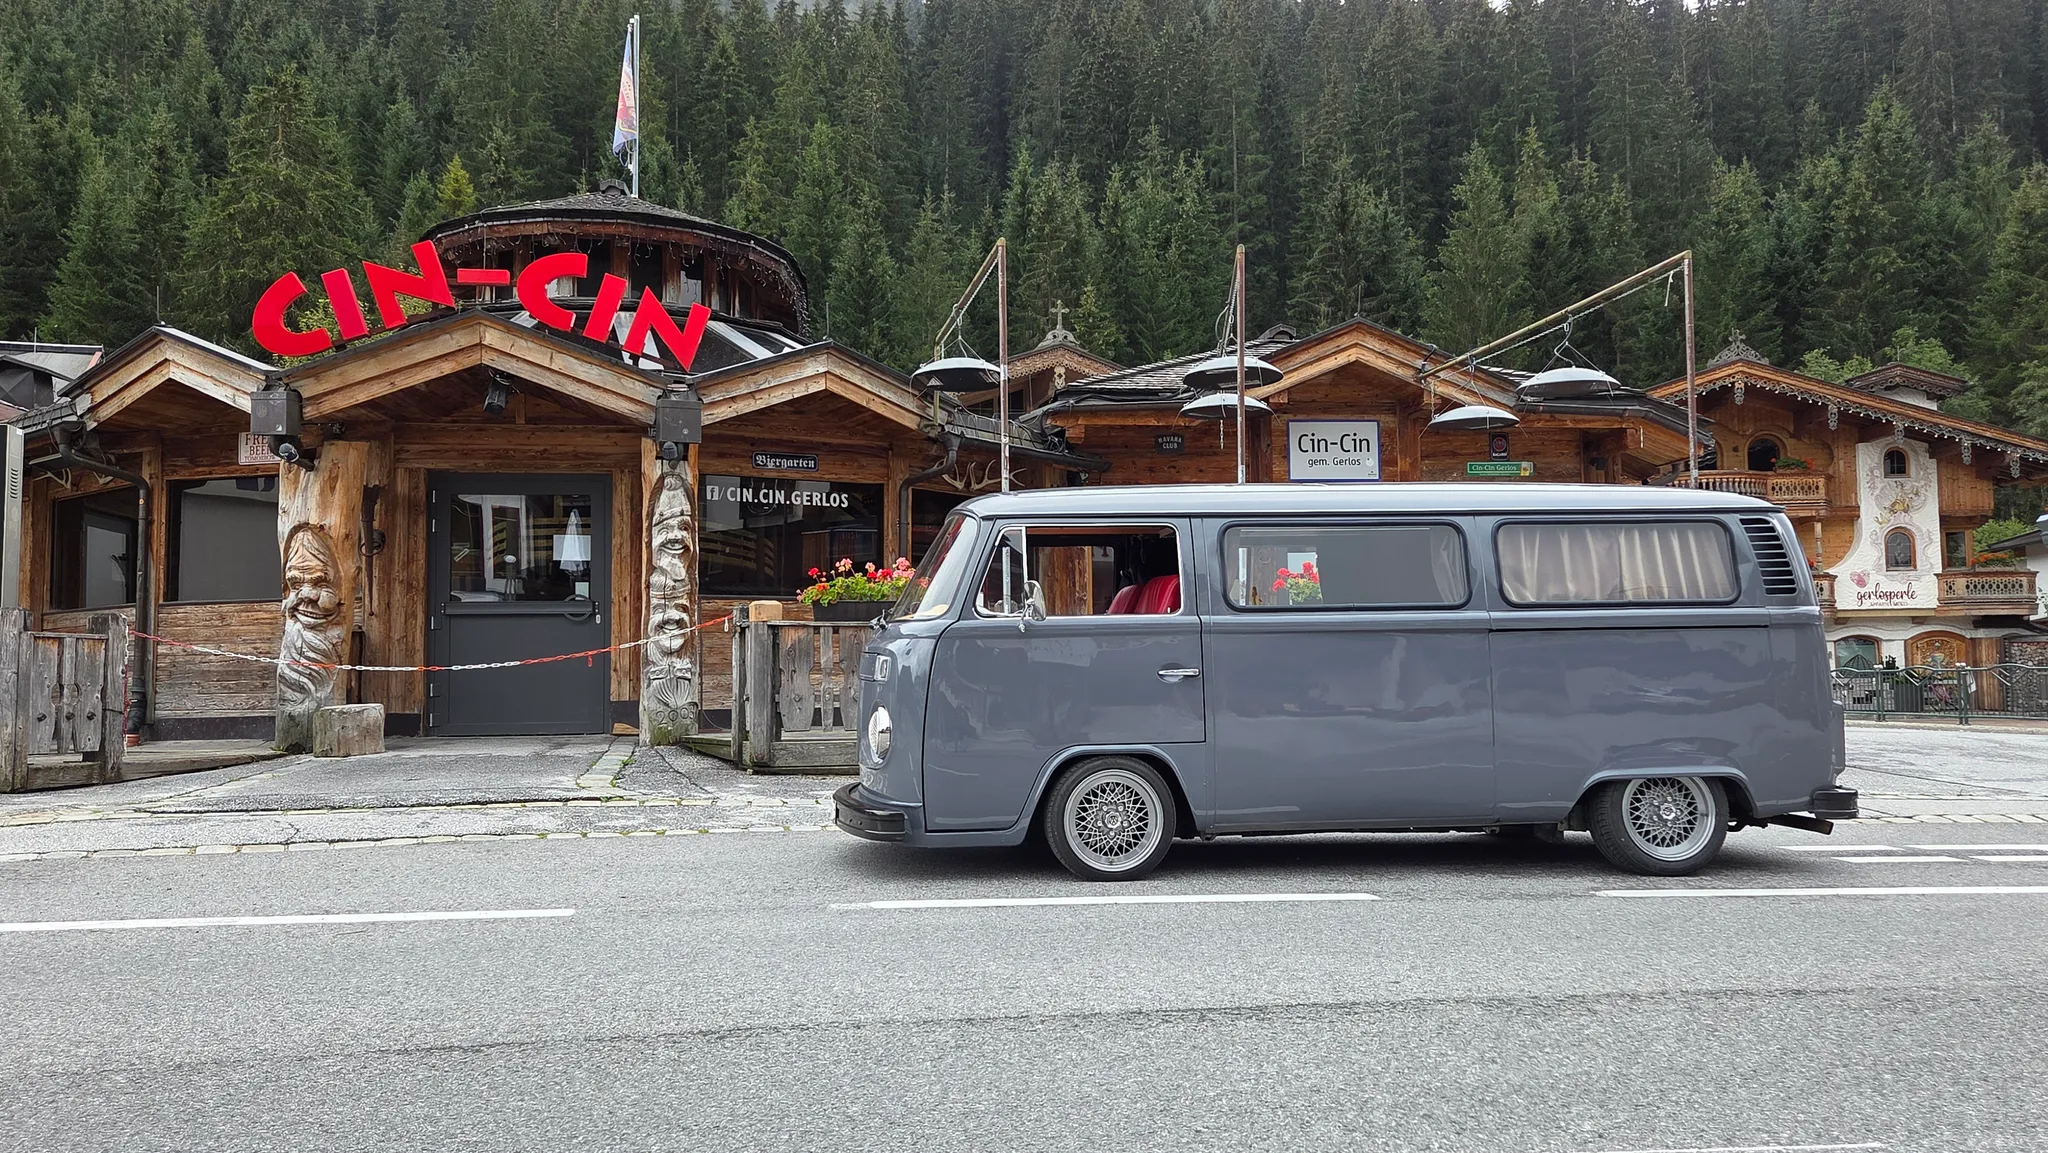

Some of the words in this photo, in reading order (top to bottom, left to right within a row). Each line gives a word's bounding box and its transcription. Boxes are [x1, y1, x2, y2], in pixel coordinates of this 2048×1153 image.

[252, 240, 711, 372] CIN-CIN
[245, 433, 269, 446] FRE
[1158, 436, 1182, 444] HAVANA
[1298, 432, 1370, 453] Cin-Cin
[756, 454, 815, 469] Biergarten
[1308, 458, 1330, 467] gem.
[1332, 457, 1361, 466] Gerlos
[1857, 582, 1918, 607] gerlosperle
